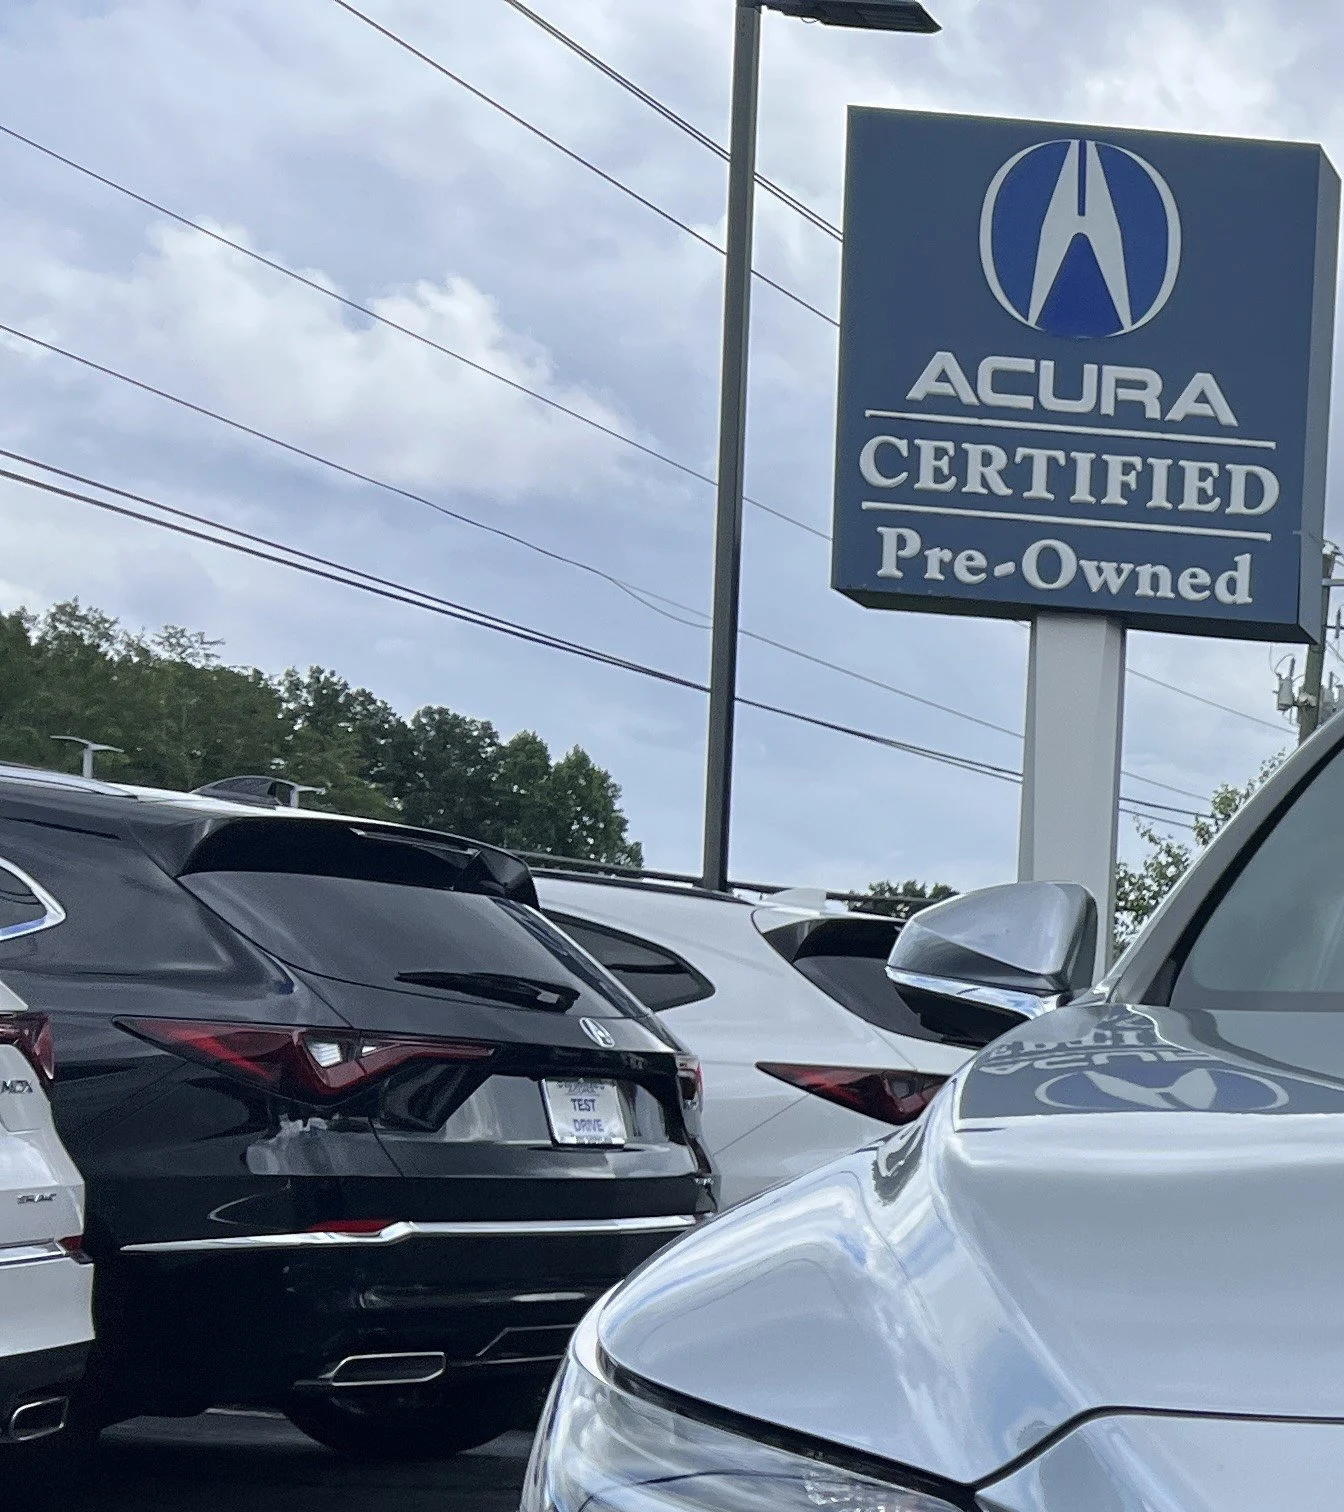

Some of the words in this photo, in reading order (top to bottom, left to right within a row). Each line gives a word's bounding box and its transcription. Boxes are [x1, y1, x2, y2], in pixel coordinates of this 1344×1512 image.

[906, 351, 1239, 427] ACURA
[858, 435, 1280, 515] CERTIFIED
[876, 526, 1253, 604] Pre-Owned
[570, 1098, 596, 1112] TEST
[573, 1119, 604, 1132] DRIVE
